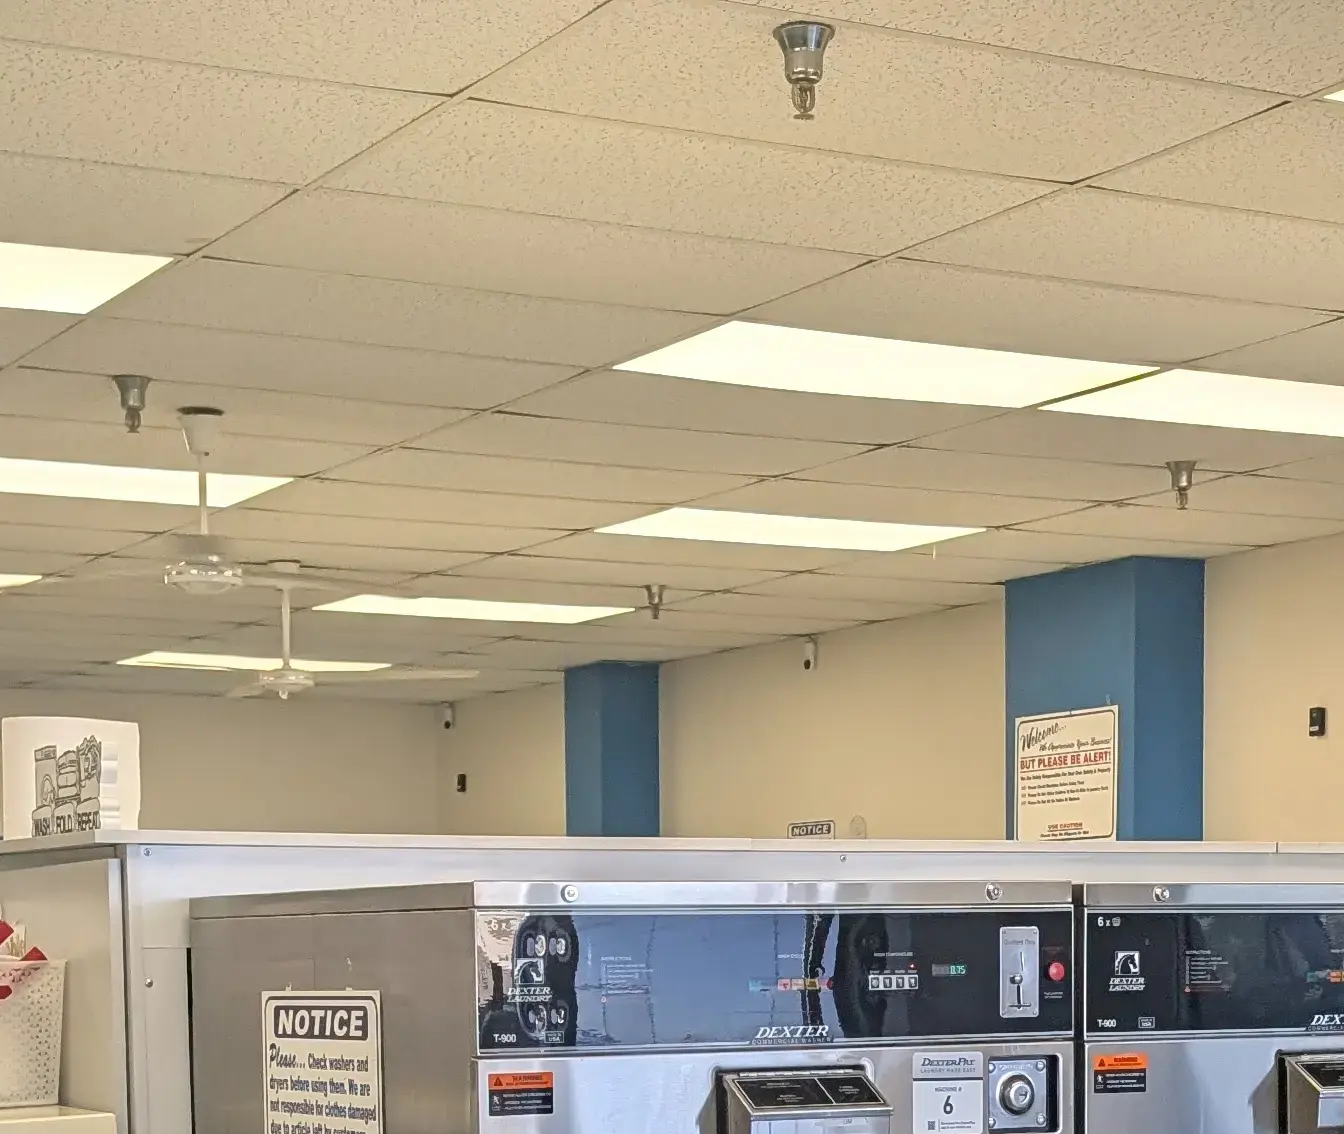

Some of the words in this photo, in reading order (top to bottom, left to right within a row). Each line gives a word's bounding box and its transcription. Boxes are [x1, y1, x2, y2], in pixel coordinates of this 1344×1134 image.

[1021, 759, 1036, 770] BUT
[1038, 755, 1068, 768] PLEASE
[1070, 754, 1081, 765] BE
[1083, 751, 1111, 763] ALERT!
[33, 818, 51, 837] WASH
[56, 814, 73, 834] FOLD
[77, 811, 101, 832] REPEAT
[792, 825, 829, 836] NOTICE
[1097, 917, 1104, 927] 6
[1109, 977, 1145, 985] DEXTER
[507, 987, 551, 996] DEXTER
[507, 995, 552, 1003] LAUNDRY
[278, 1009, 364, 1037] NOTICE
[1097, 1019, 1117, 1027] T-900
[756, 1025, 829, 1039] DEXTER
[493, 1034, 517, 1043] T-900
[751, 1038, 799, 1046] COMMERCIAL
[308, 1053, 327, 1070] Check
[329, 1053, 355, 1071] washers
[356, 1056, 368, 1072] and
[921, 1057, 976, 1067] DEXTERPAY
[269, 1074, 288, 1094] dryers
[290, 1075, 309, 1092] before
[311, 1077, 327, 1097] using
[329, 1078, 347, 1095] them.
[348, 1078, 358, 1096] We
[359, 1083, 370, 1097] are
[270, 1098, 279, 1113] not
[281, 1099, 314, 1117] responsible
[315, 1100, 324, 1116] for
[325, 1102, 346, 1119] clothes
[348, 1104, 376, 1124] damaged
[943, 1095, 954, 1115] 6
[270, 1119, 282, 1134] due
